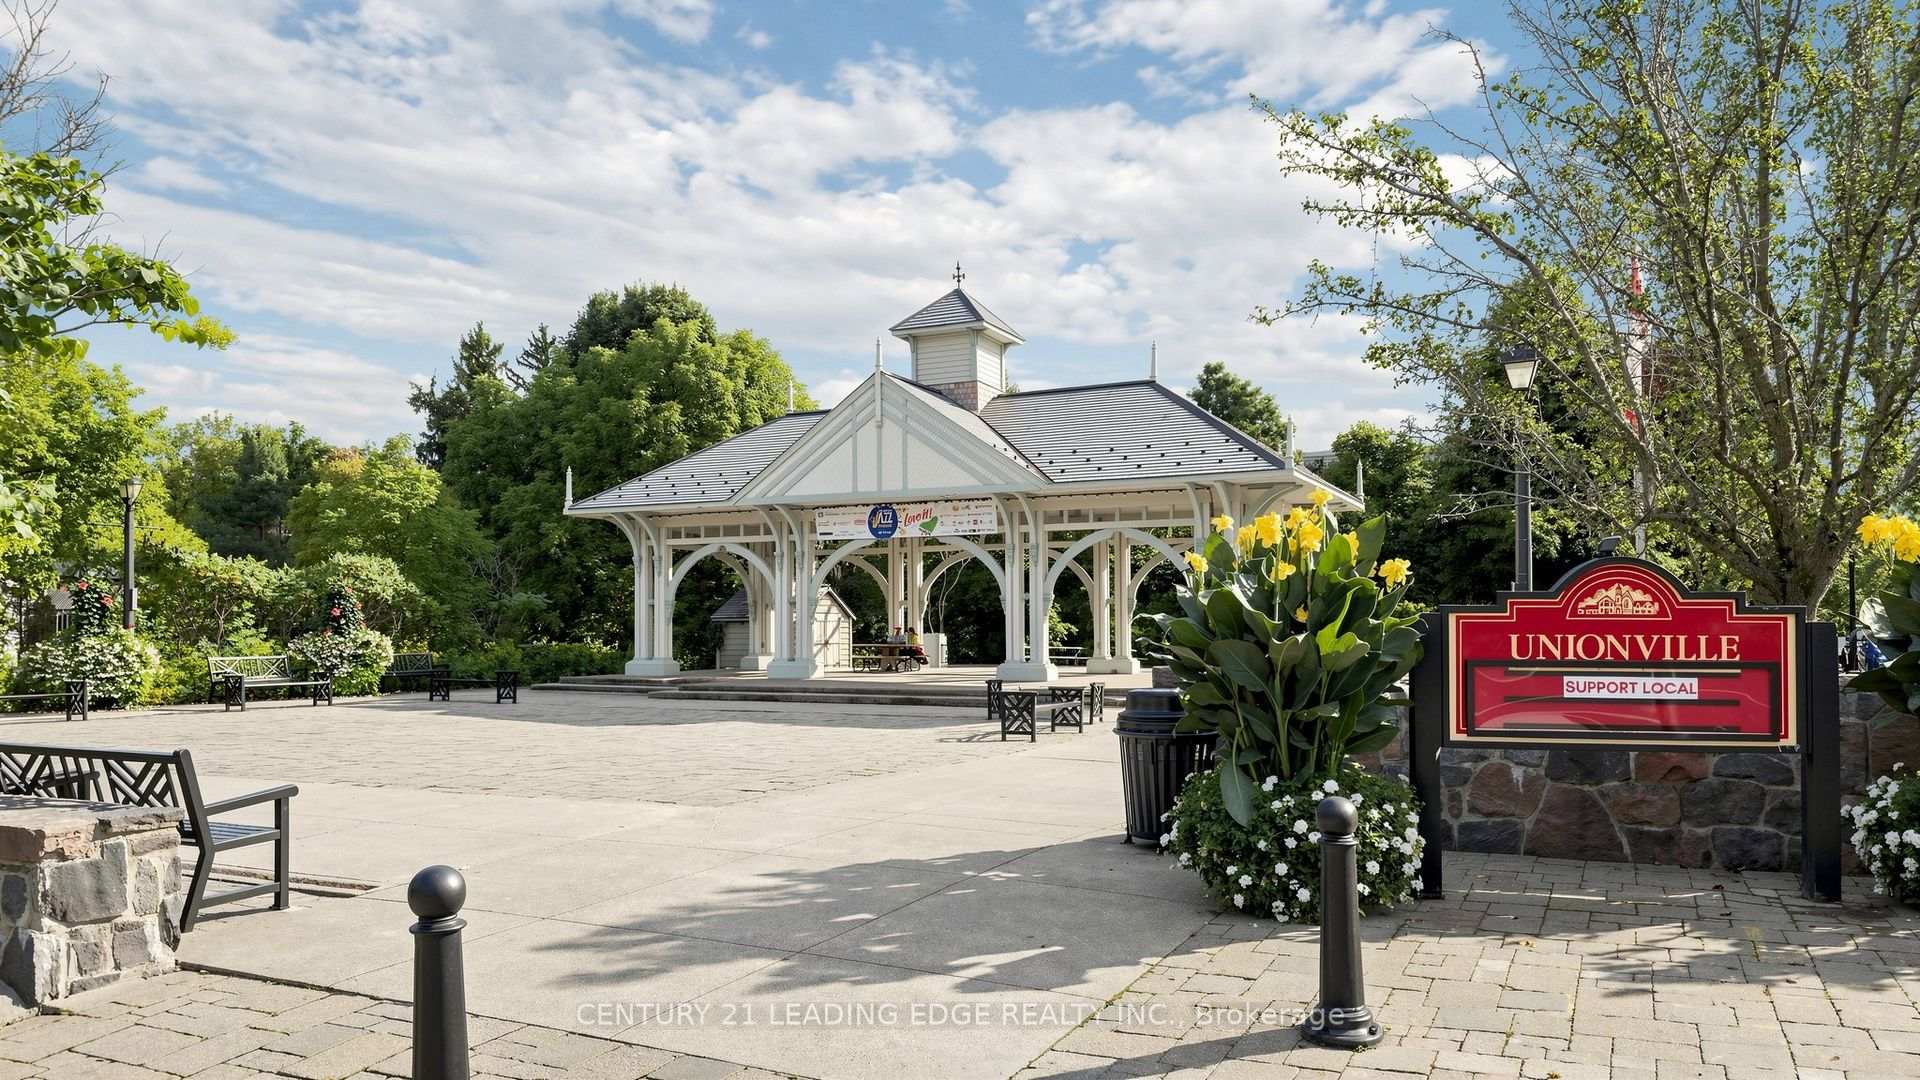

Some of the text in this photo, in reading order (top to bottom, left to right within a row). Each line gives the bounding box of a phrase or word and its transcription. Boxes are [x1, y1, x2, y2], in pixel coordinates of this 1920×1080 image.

[1508, 633, 1741, 661] UNIONVILLE
[1565, 680, 1697, 695] SUPPORT LOCAL
